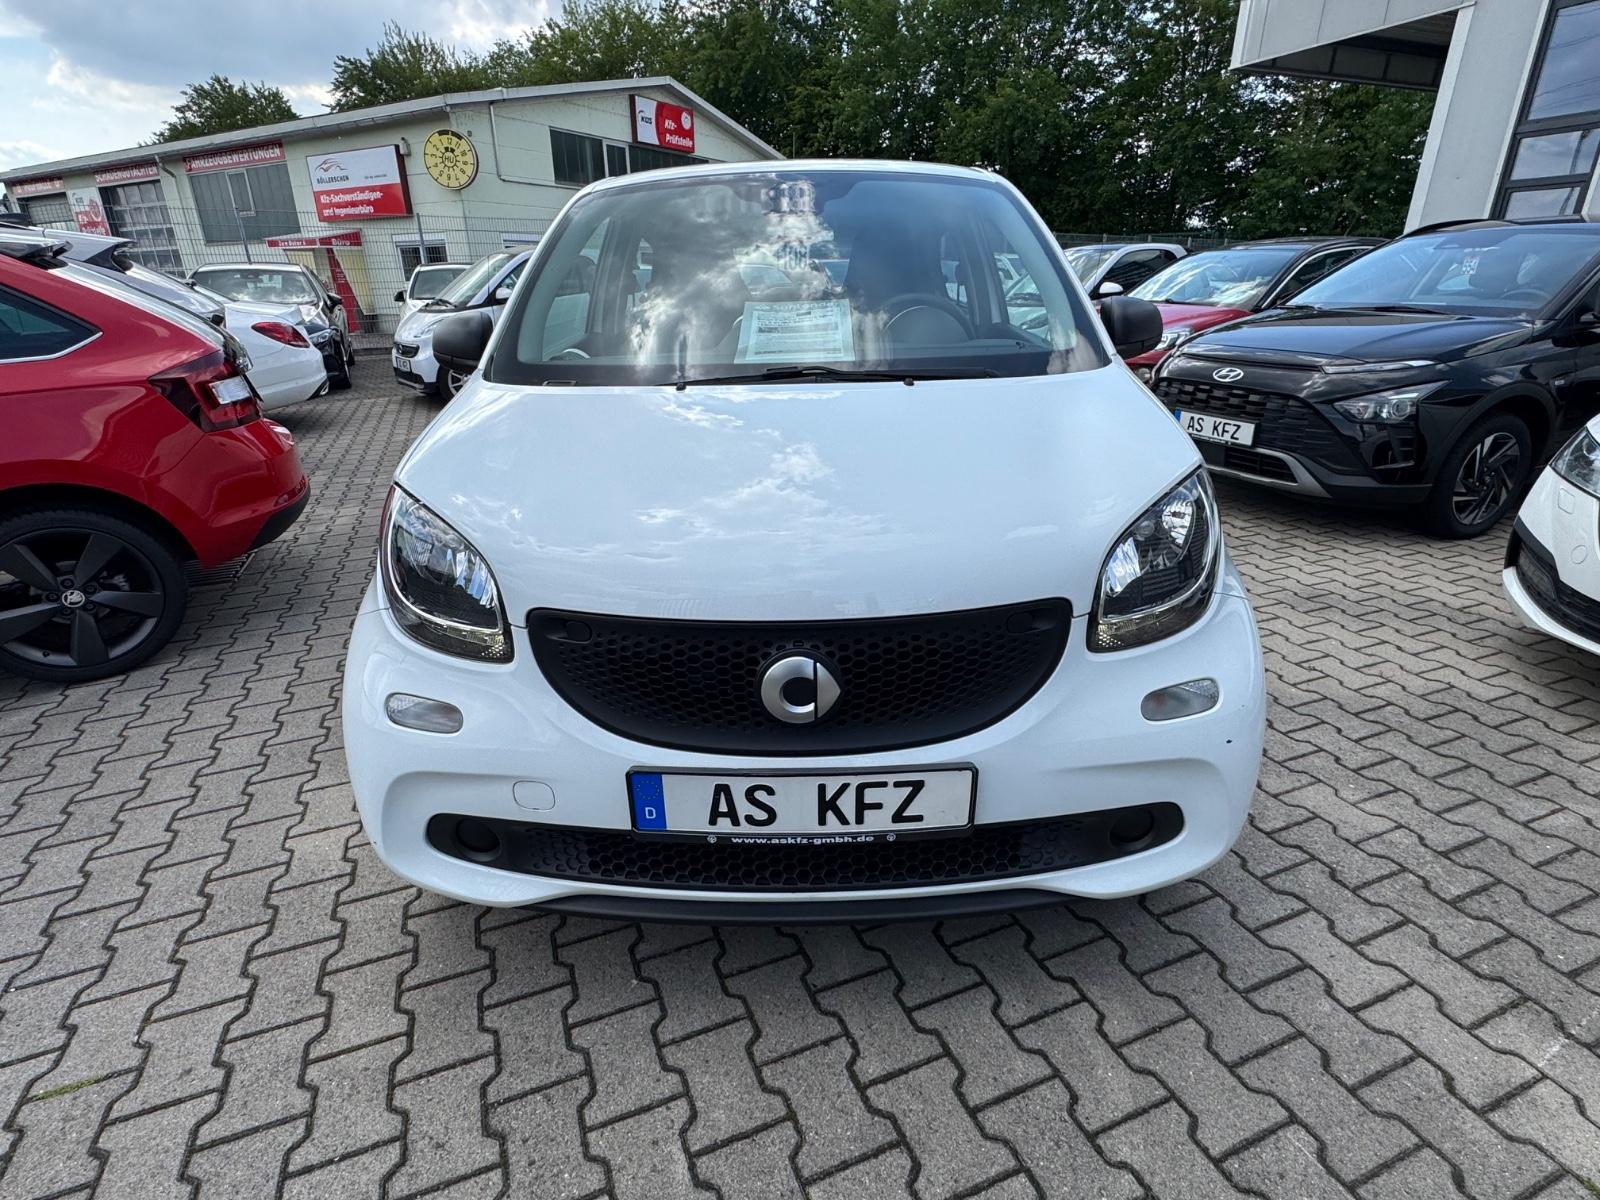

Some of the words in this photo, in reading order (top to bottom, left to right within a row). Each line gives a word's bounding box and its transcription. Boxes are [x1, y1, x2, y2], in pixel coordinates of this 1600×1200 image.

[664, 119, 677, 130] Kfz-
[446, 137, 453, 145] 12
[665, 133, 693, 148] Prüfstelle
[186, 145, 281, 169] FAHRZEUGBEWERTUNGEN
[444, 155, 455, 164] HU
[320, 190, 384, 203] Kfz-Sachverständigen-
[322, 207, 334, 217] und
[334, 204, 375, 217] Ingenieurbüro
[331, 238, 351, 246] Büro
[1187, 415, 1205, 433] AS
[1211, 420, 1241, 441] KFZ
[708, 783, 778, 827] AS
[817, 779, 926, 827] KFZ
[645, 807, 657, 820] D
[731, 834, 875, 845] www.askfz-gmbh.de
